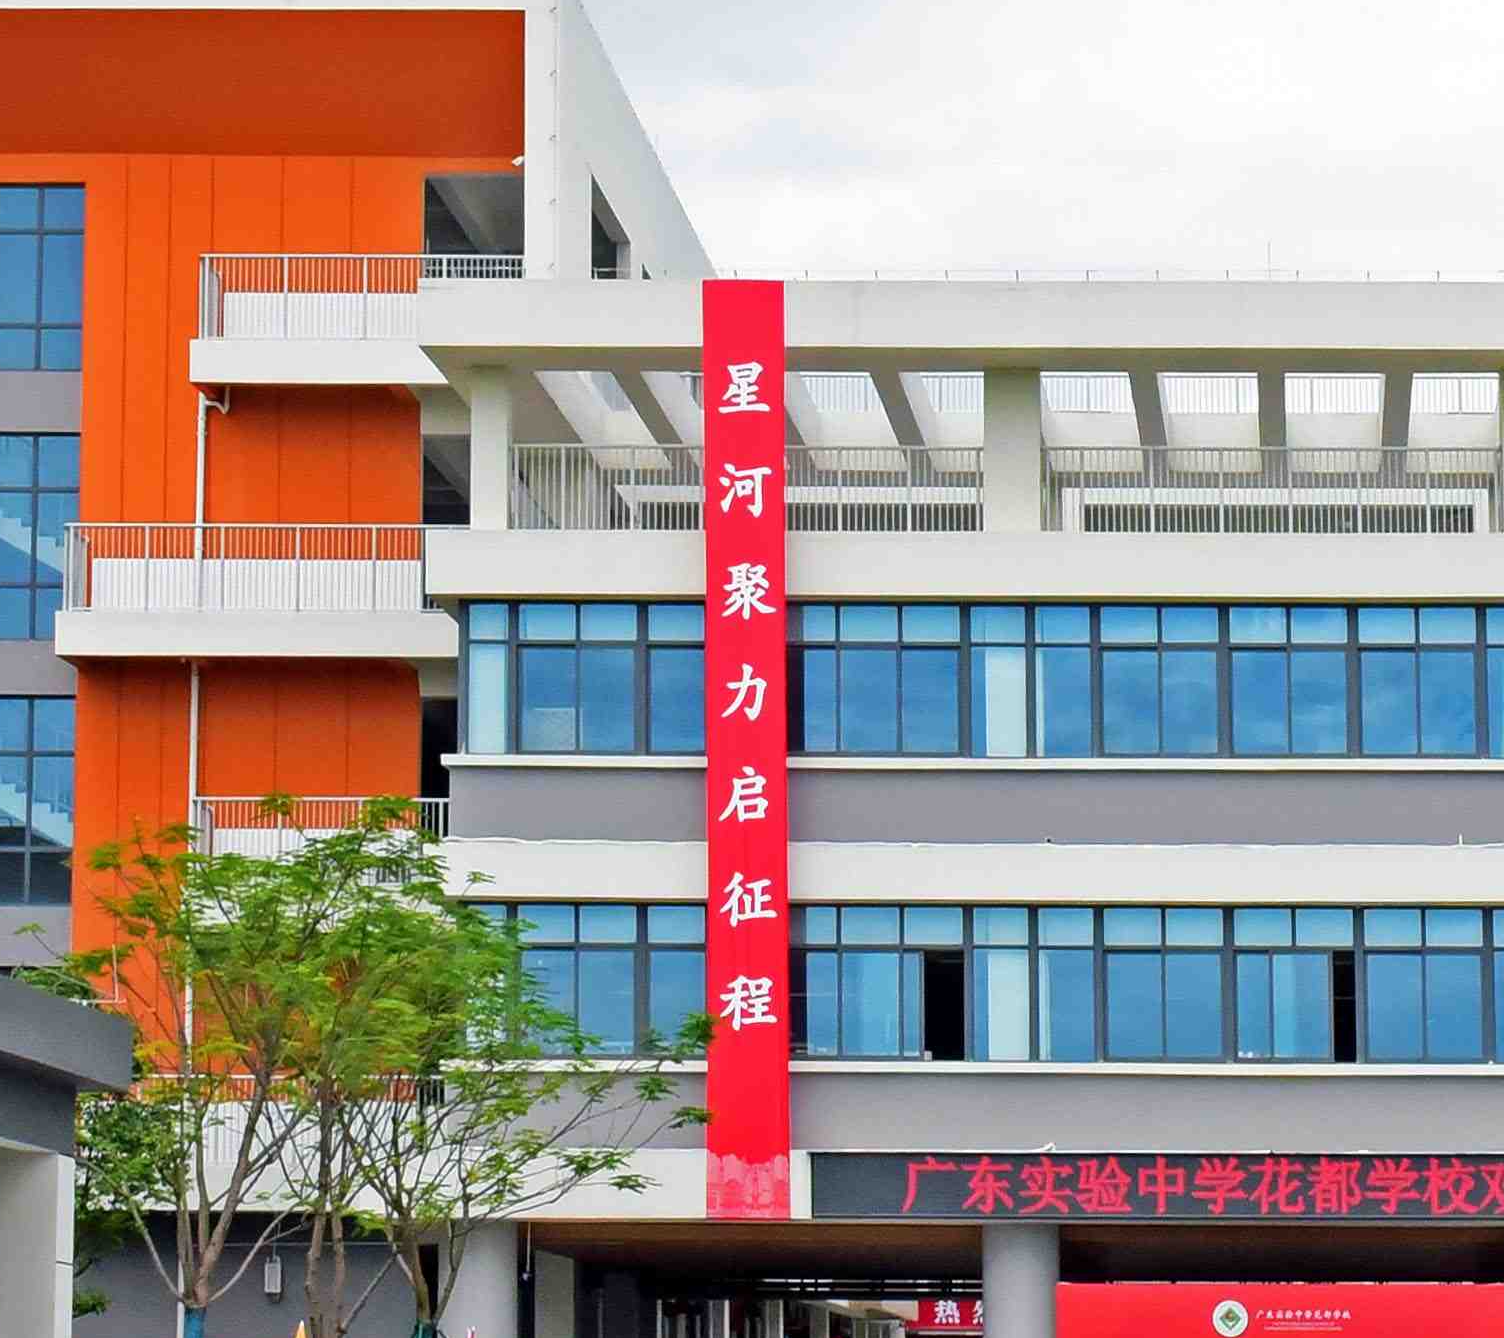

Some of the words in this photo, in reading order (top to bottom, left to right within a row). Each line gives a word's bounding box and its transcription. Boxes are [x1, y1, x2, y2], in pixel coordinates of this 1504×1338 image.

[718, 361, 779, 1032] 星河聚力启征程
